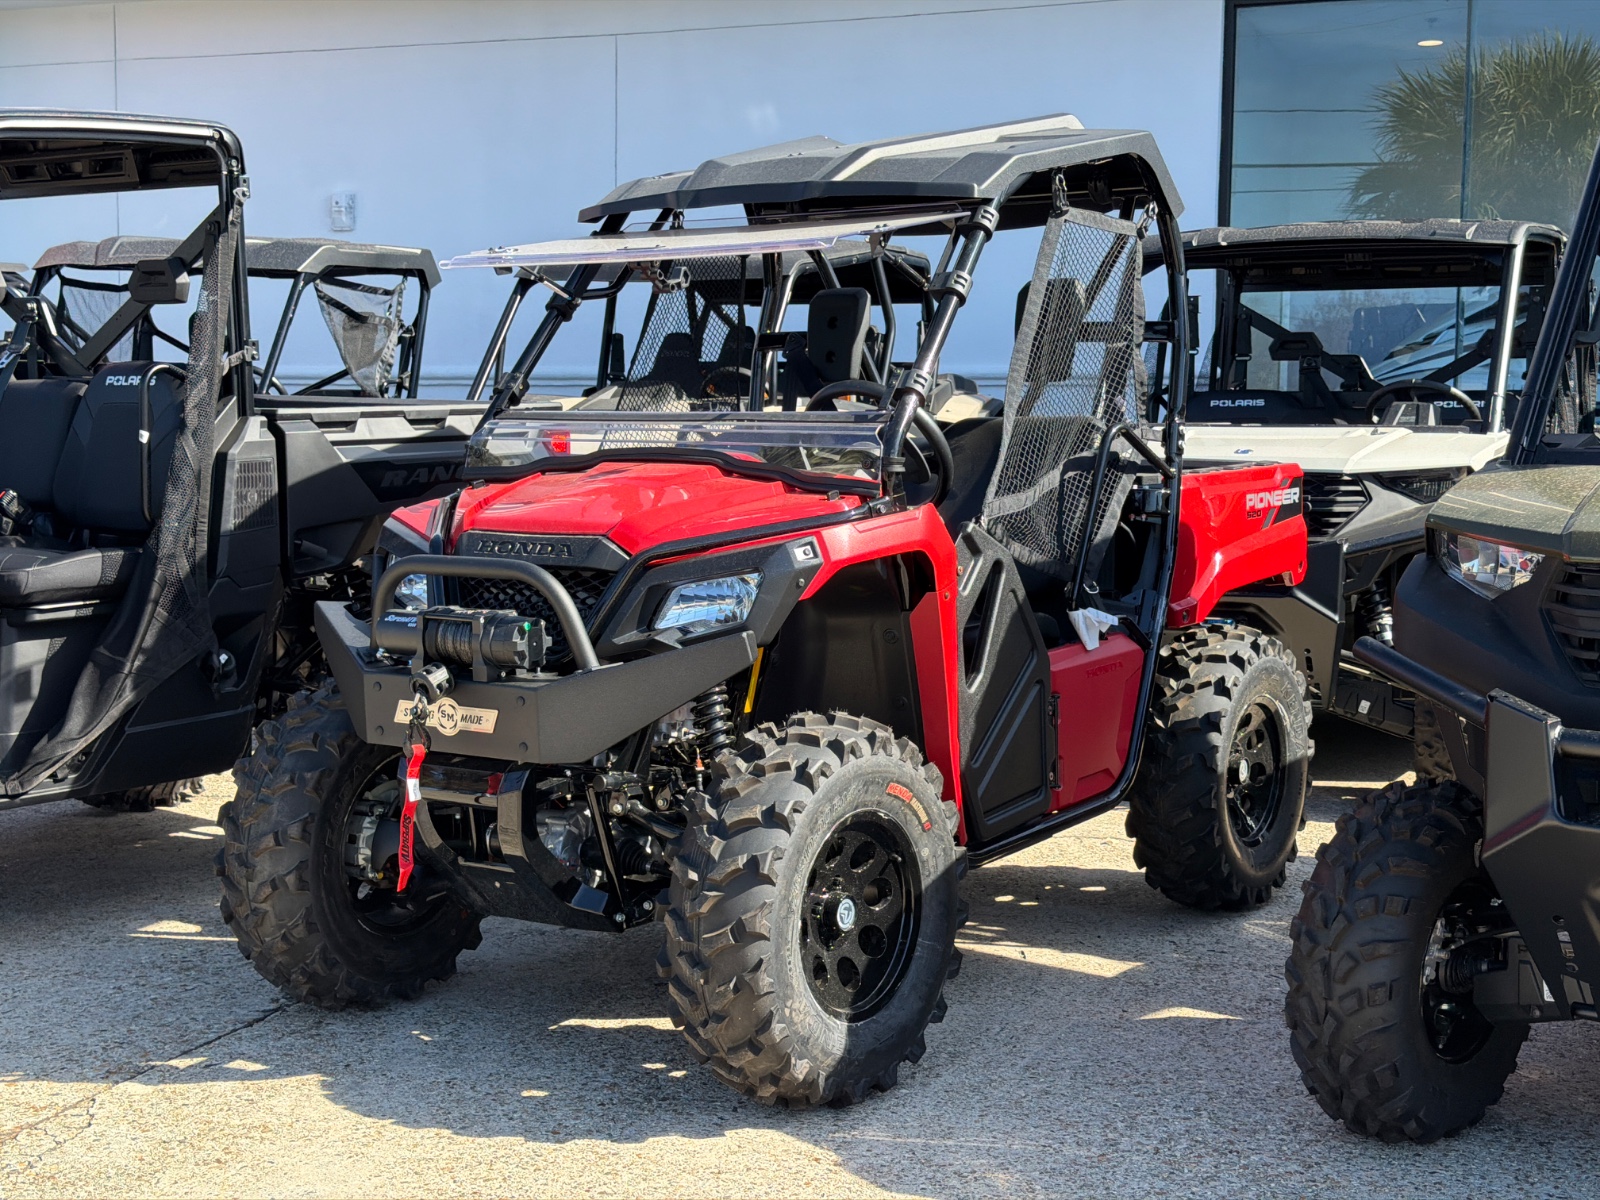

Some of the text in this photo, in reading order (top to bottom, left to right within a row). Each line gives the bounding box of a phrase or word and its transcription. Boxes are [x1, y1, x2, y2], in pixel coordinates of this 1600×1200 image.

[105, 375, 157, 386] POLARS
[1210, 399, 1266, 407] POLARIS
[1246, 487, 1300, 510] PIONEER
[1247, 510, 1262, 519] 520
[474, 540, 574, 557] HONDA
[440, 709, 455, 722] SM
[460, 713, 484, 725] MADE
[886, 782, 914, 803] KENDA
